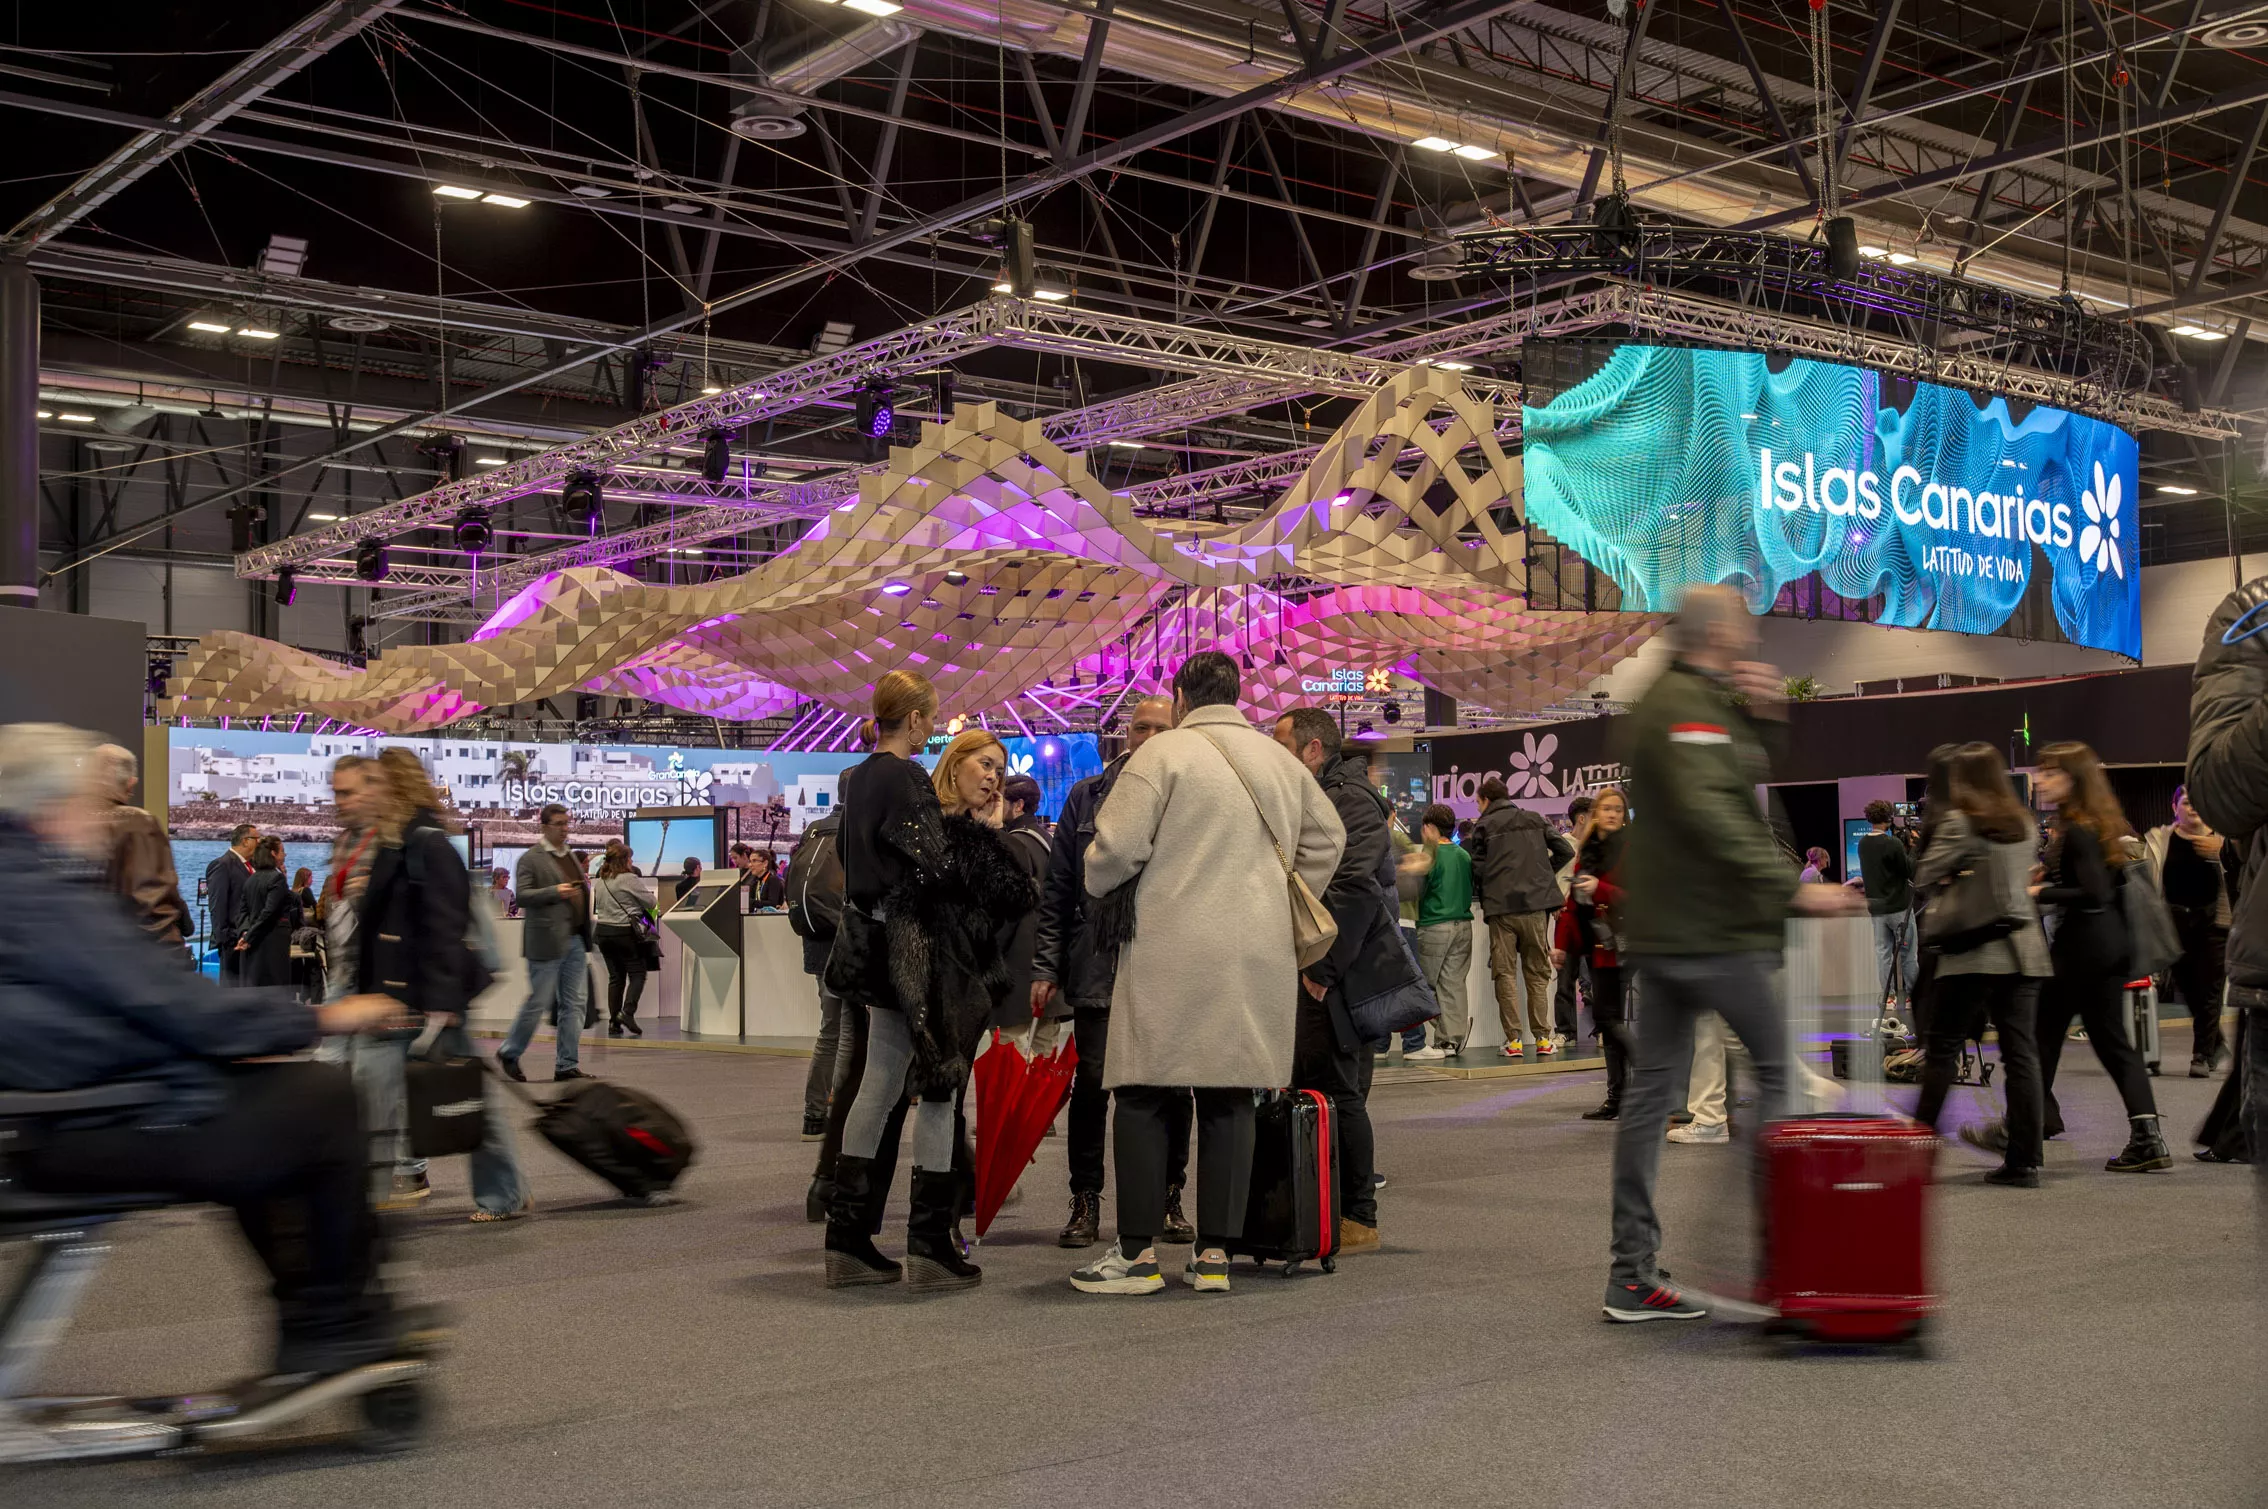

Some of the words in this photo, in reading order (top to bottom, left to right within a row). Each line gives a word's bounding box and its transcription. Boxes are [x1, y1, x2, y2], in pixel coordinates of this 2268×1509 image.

[1760, 447, 1882, 520] Islas
[1891, 464, 2073, 548] Canarias
[1921, 544, 1973, 577] LATITUD
[1977, 555, 1994, 579] DE
[1995, 555, 2025, 583] VIDA
[1332, 668, 1364, 680] Islas
[1301, 679, 1364, 692] Canarias
[505, 780, 560, 802] Islas
[564, 781, 669, 805] Canarias
[580, 809, 609, 819] LATITUD
[611, 810, 621, 819] DE
[621, 810, 637, 819] VDA
